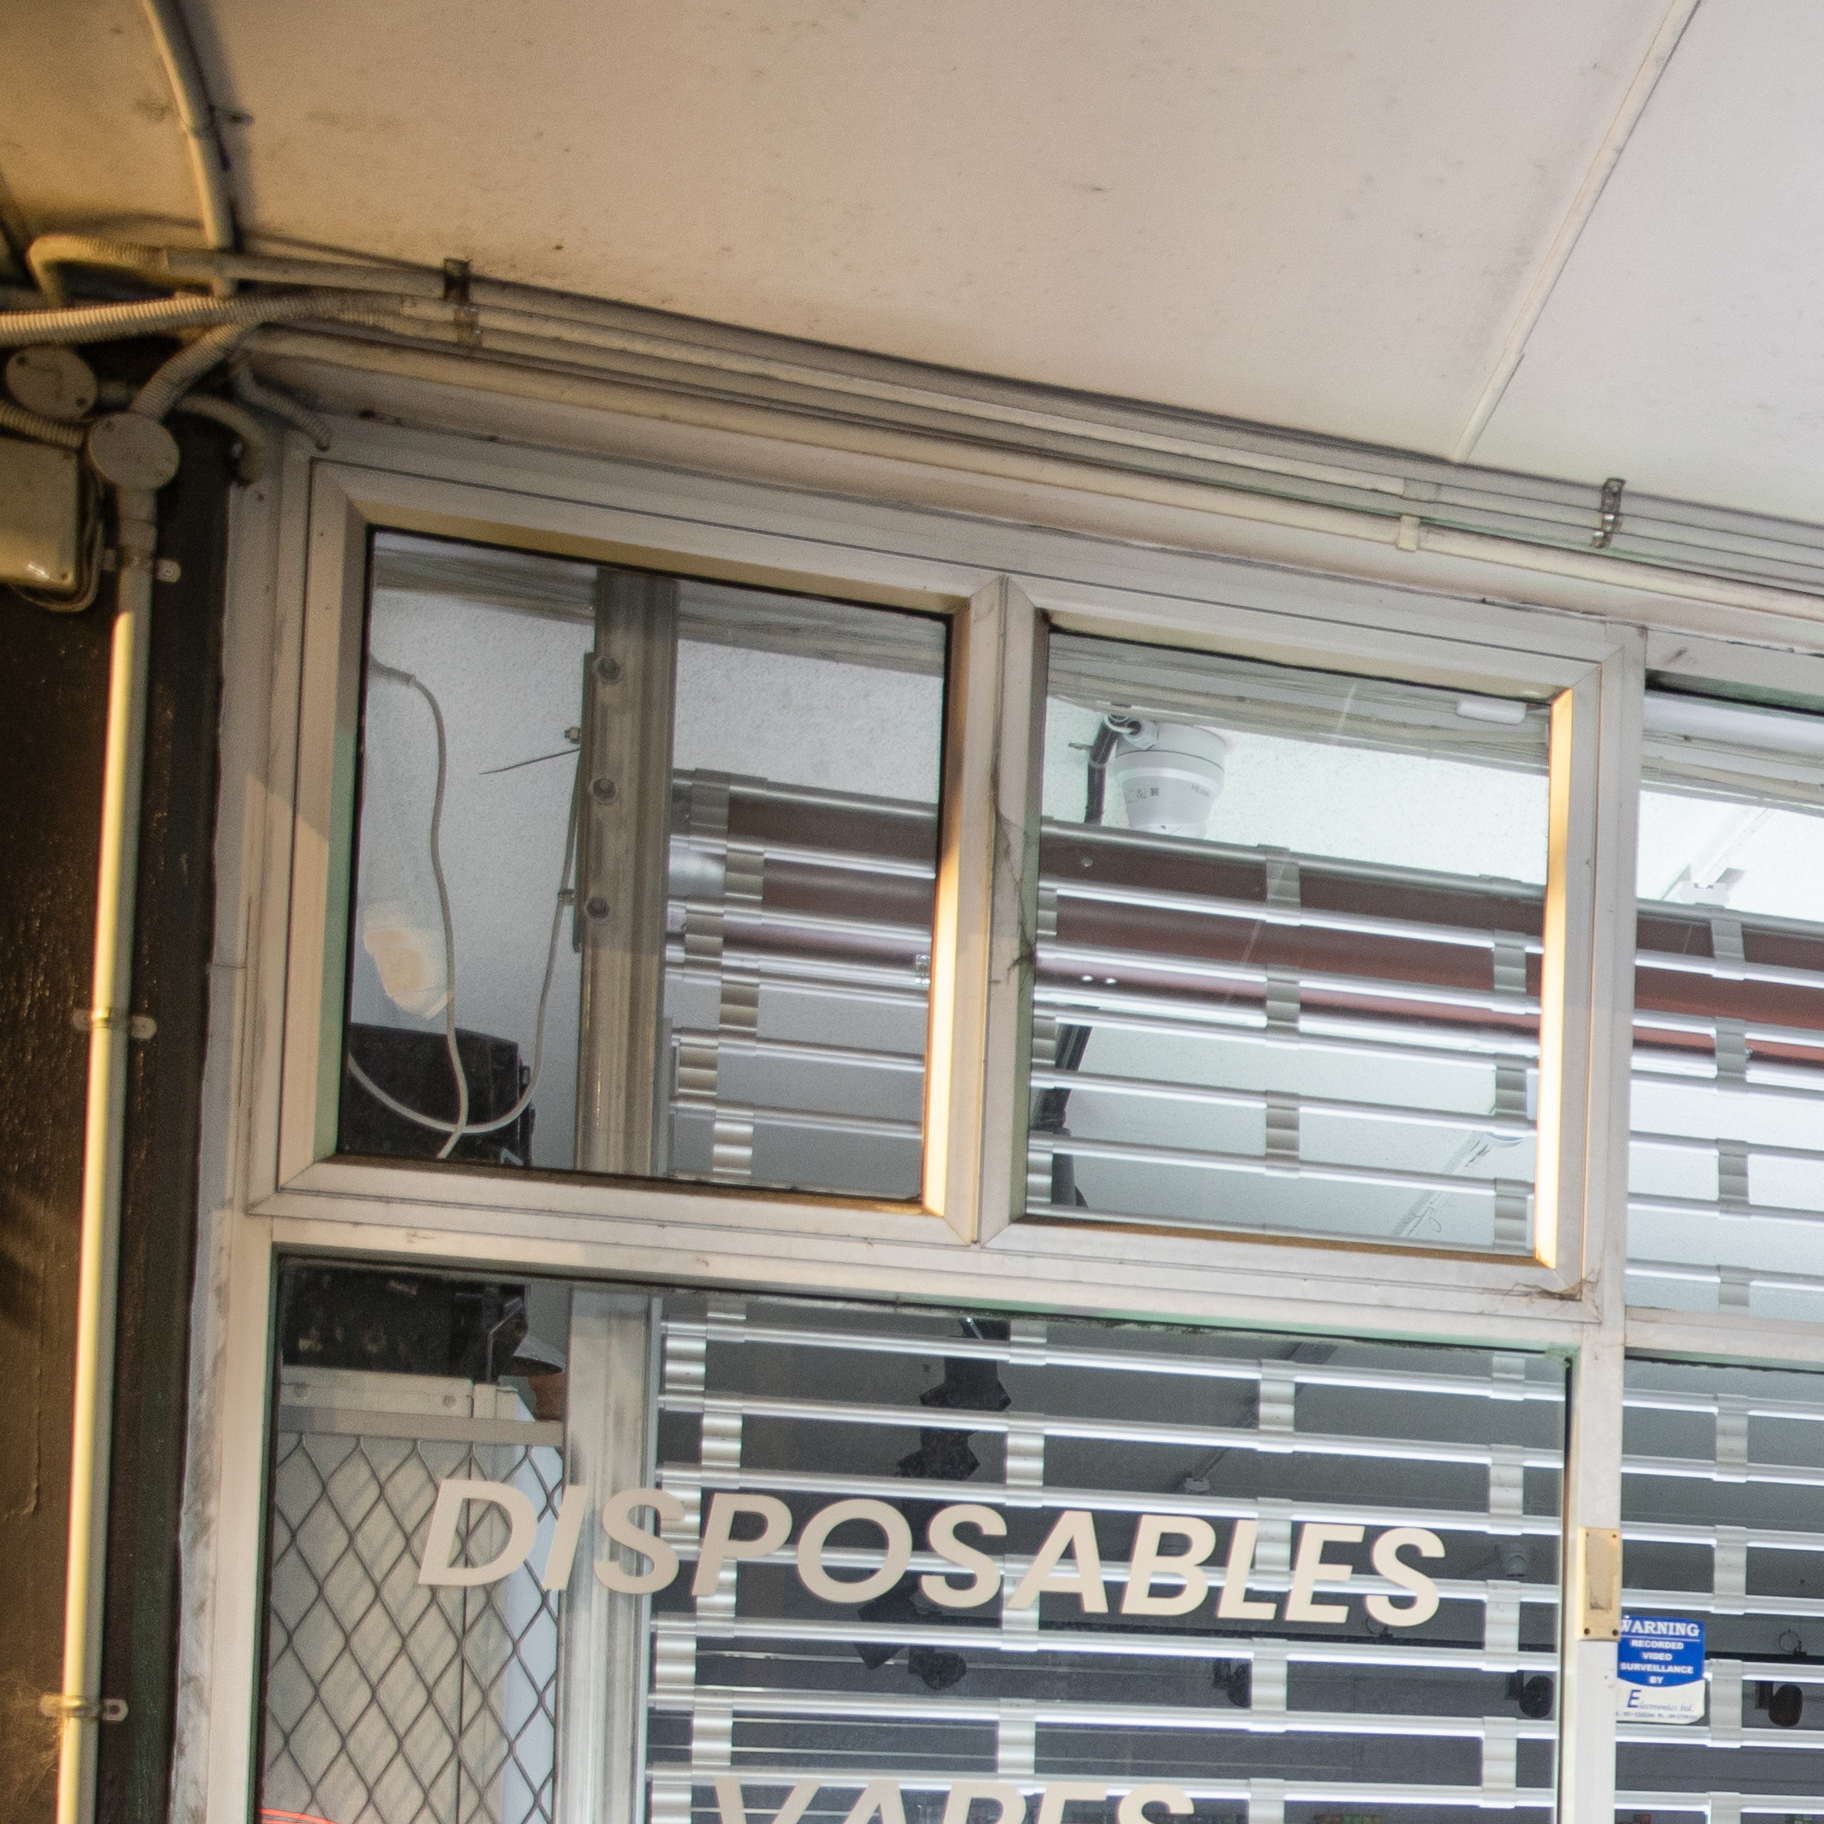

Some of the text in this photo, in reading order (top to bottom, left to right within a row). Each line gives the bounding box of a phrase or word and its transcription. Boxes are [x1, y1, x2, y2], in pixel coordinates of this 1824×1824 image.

[418, 1478, 1447, 1627] DISPOSABLES
[1620, 1619, 1700, 1637] WARNING
[1630, 1639, 1684, 1650] RECORDED
[1642, 1651, 1673, 1661] VIDEO
[1619, 1662, 1694, 1674] SURVEILLANCE
[1648, 1675, 1664, 1684] BY
[1627, 1689, 1678, 1711] Electronics
